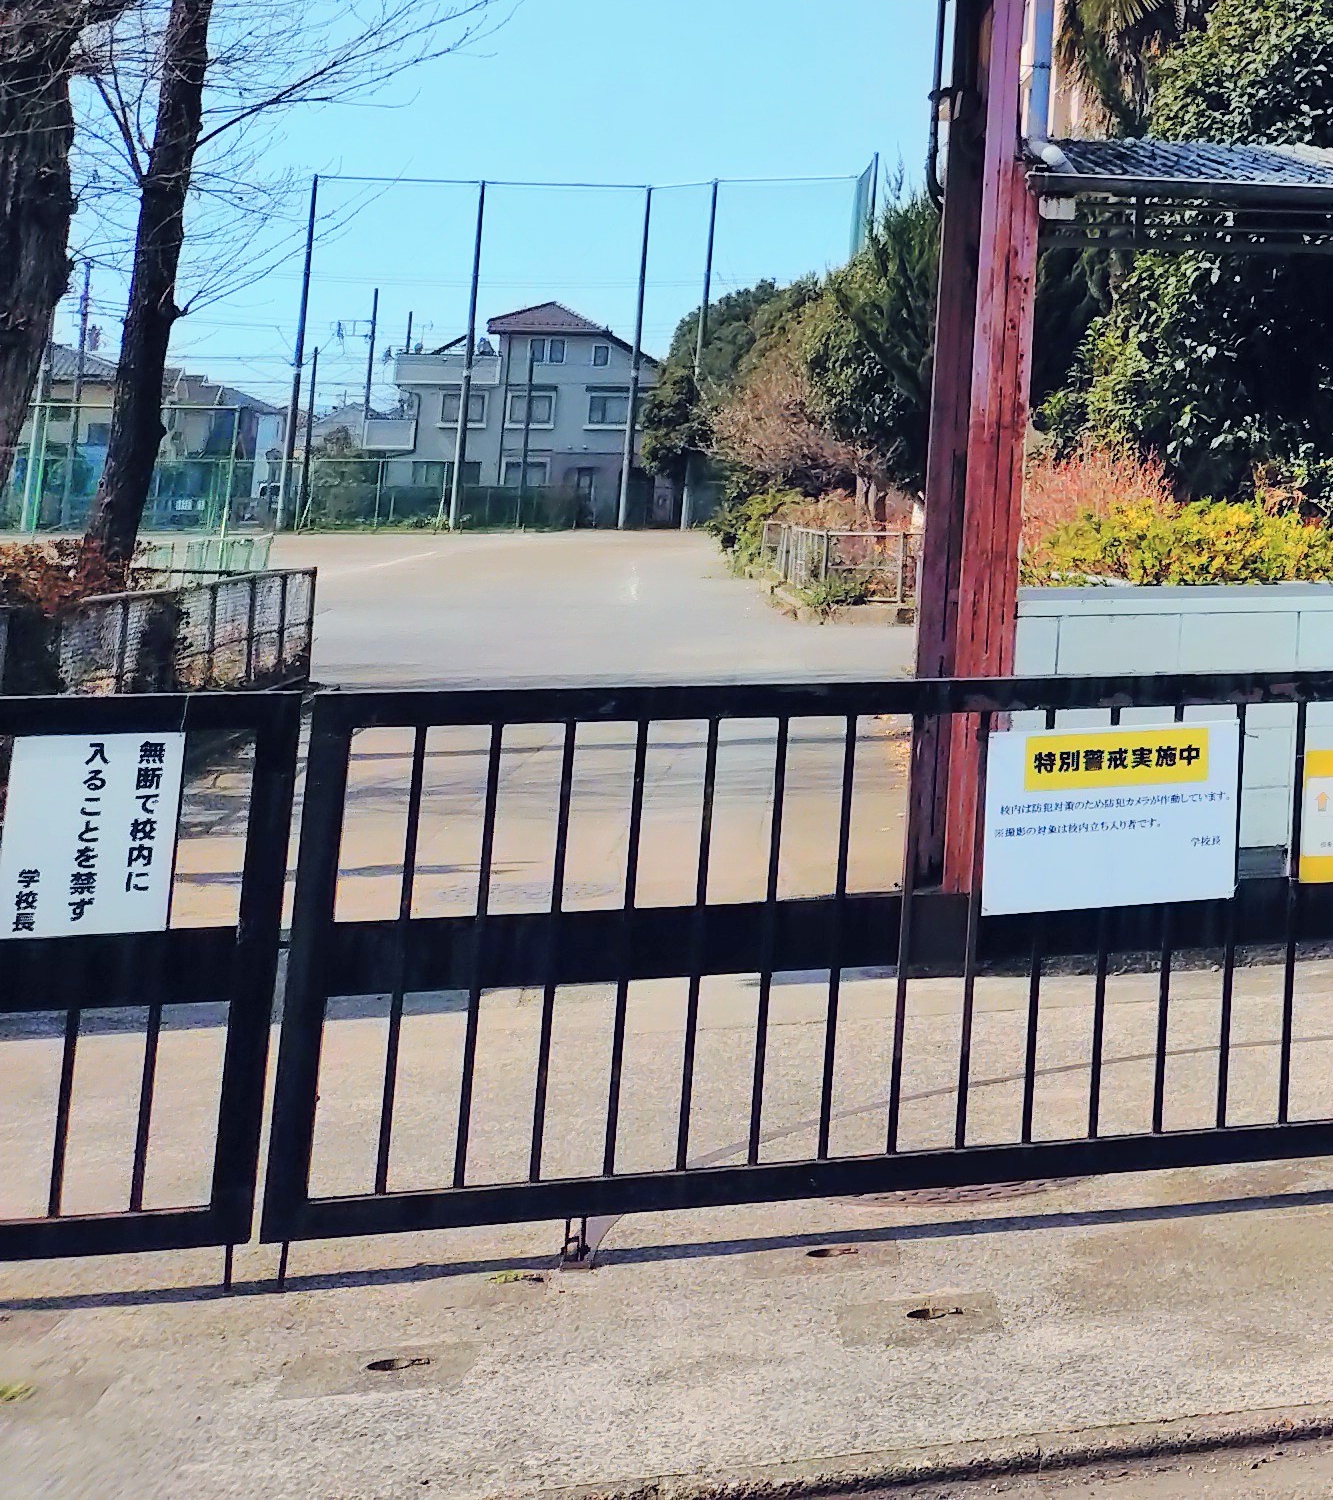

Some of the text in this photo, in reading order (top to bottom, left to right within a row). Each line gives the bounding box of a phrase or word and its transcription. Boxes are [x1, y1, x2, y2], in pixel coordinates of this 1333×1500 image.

[1033, 744, 1201, 775] 特別警戒実施中
[68, 742, 111, 922] 入ることを禁ず
[125, 741, 166, 893] 無断で校内に
[1190, 835, 1221, 847] 学校長
[12, 868, 41, 932] 学校長
